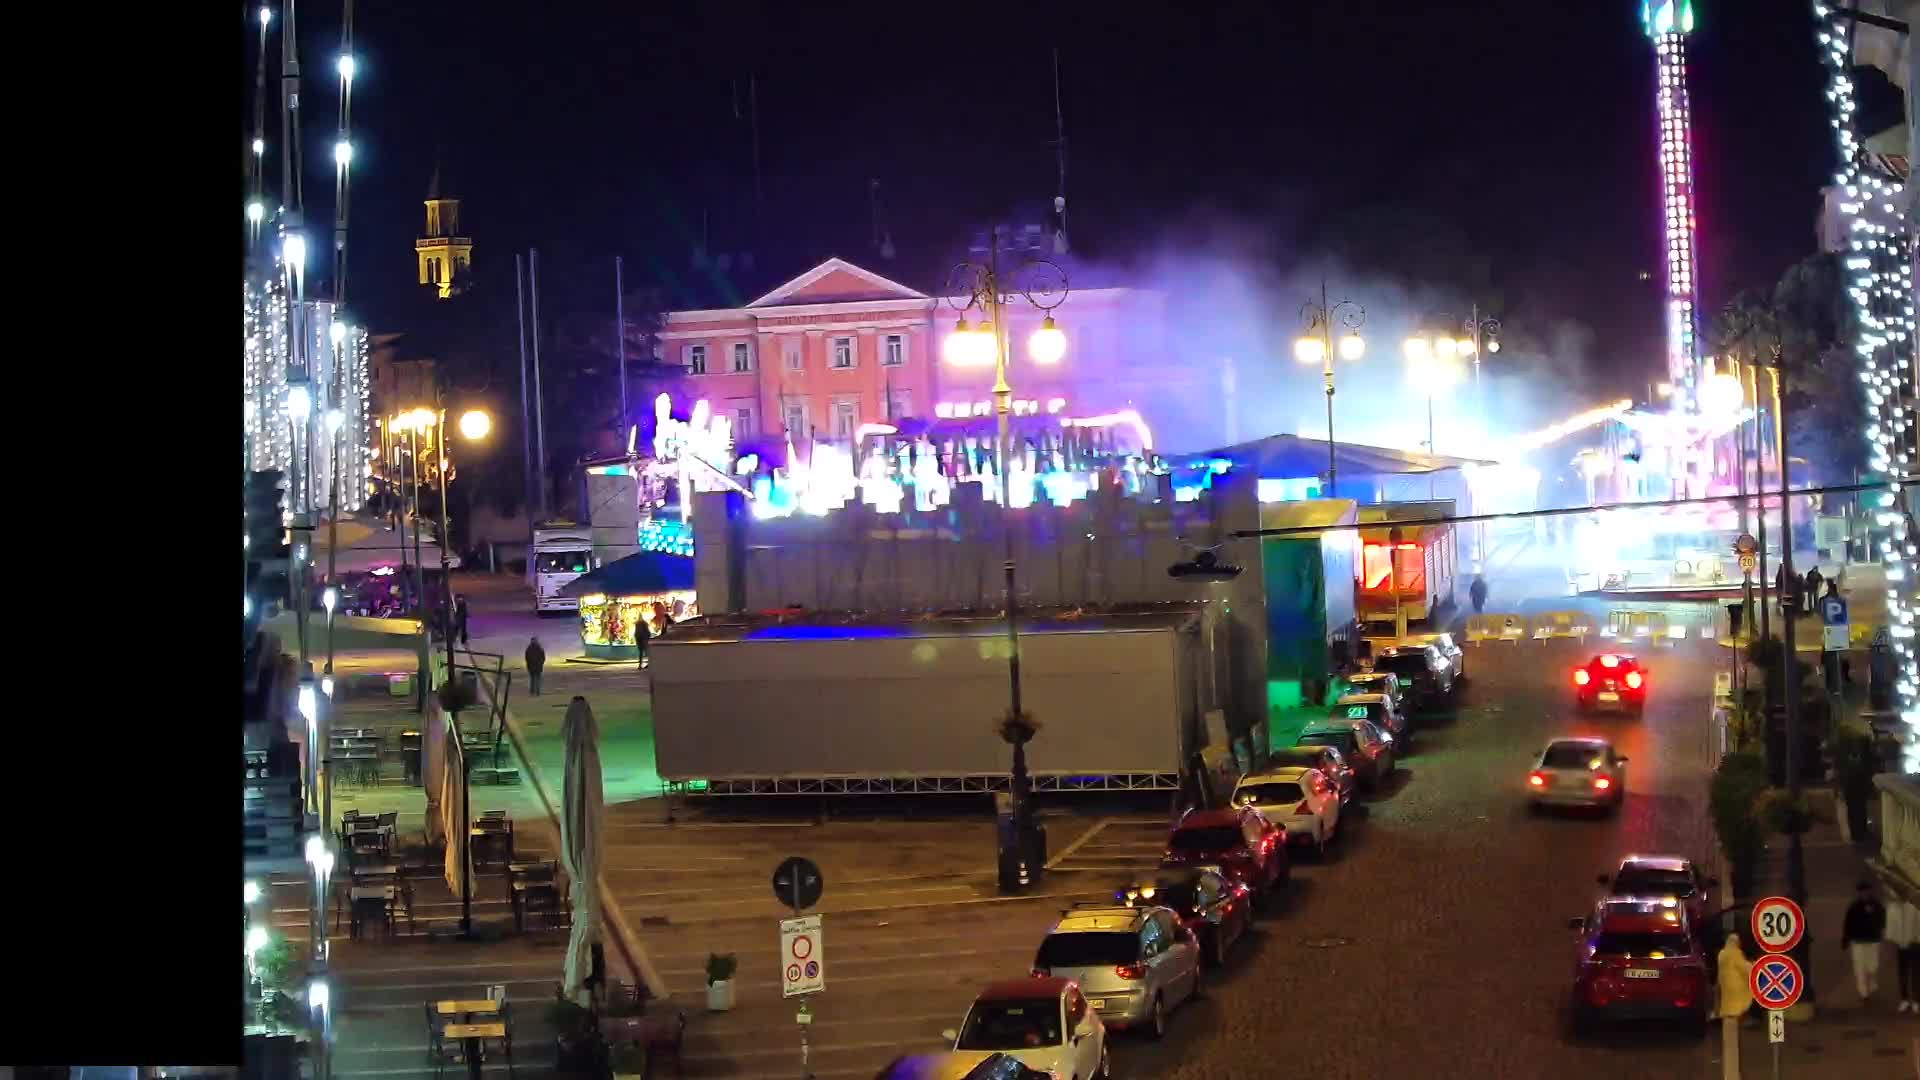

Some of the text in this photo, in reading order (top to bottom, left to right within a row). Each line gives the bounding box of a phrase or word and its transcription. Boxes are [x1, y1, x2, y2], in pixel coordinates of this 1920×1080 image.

[1742, 558, 1753, 567] 20
[1826, 602, 1843, 625] P
[1762, 911, 1792, 938] 30
